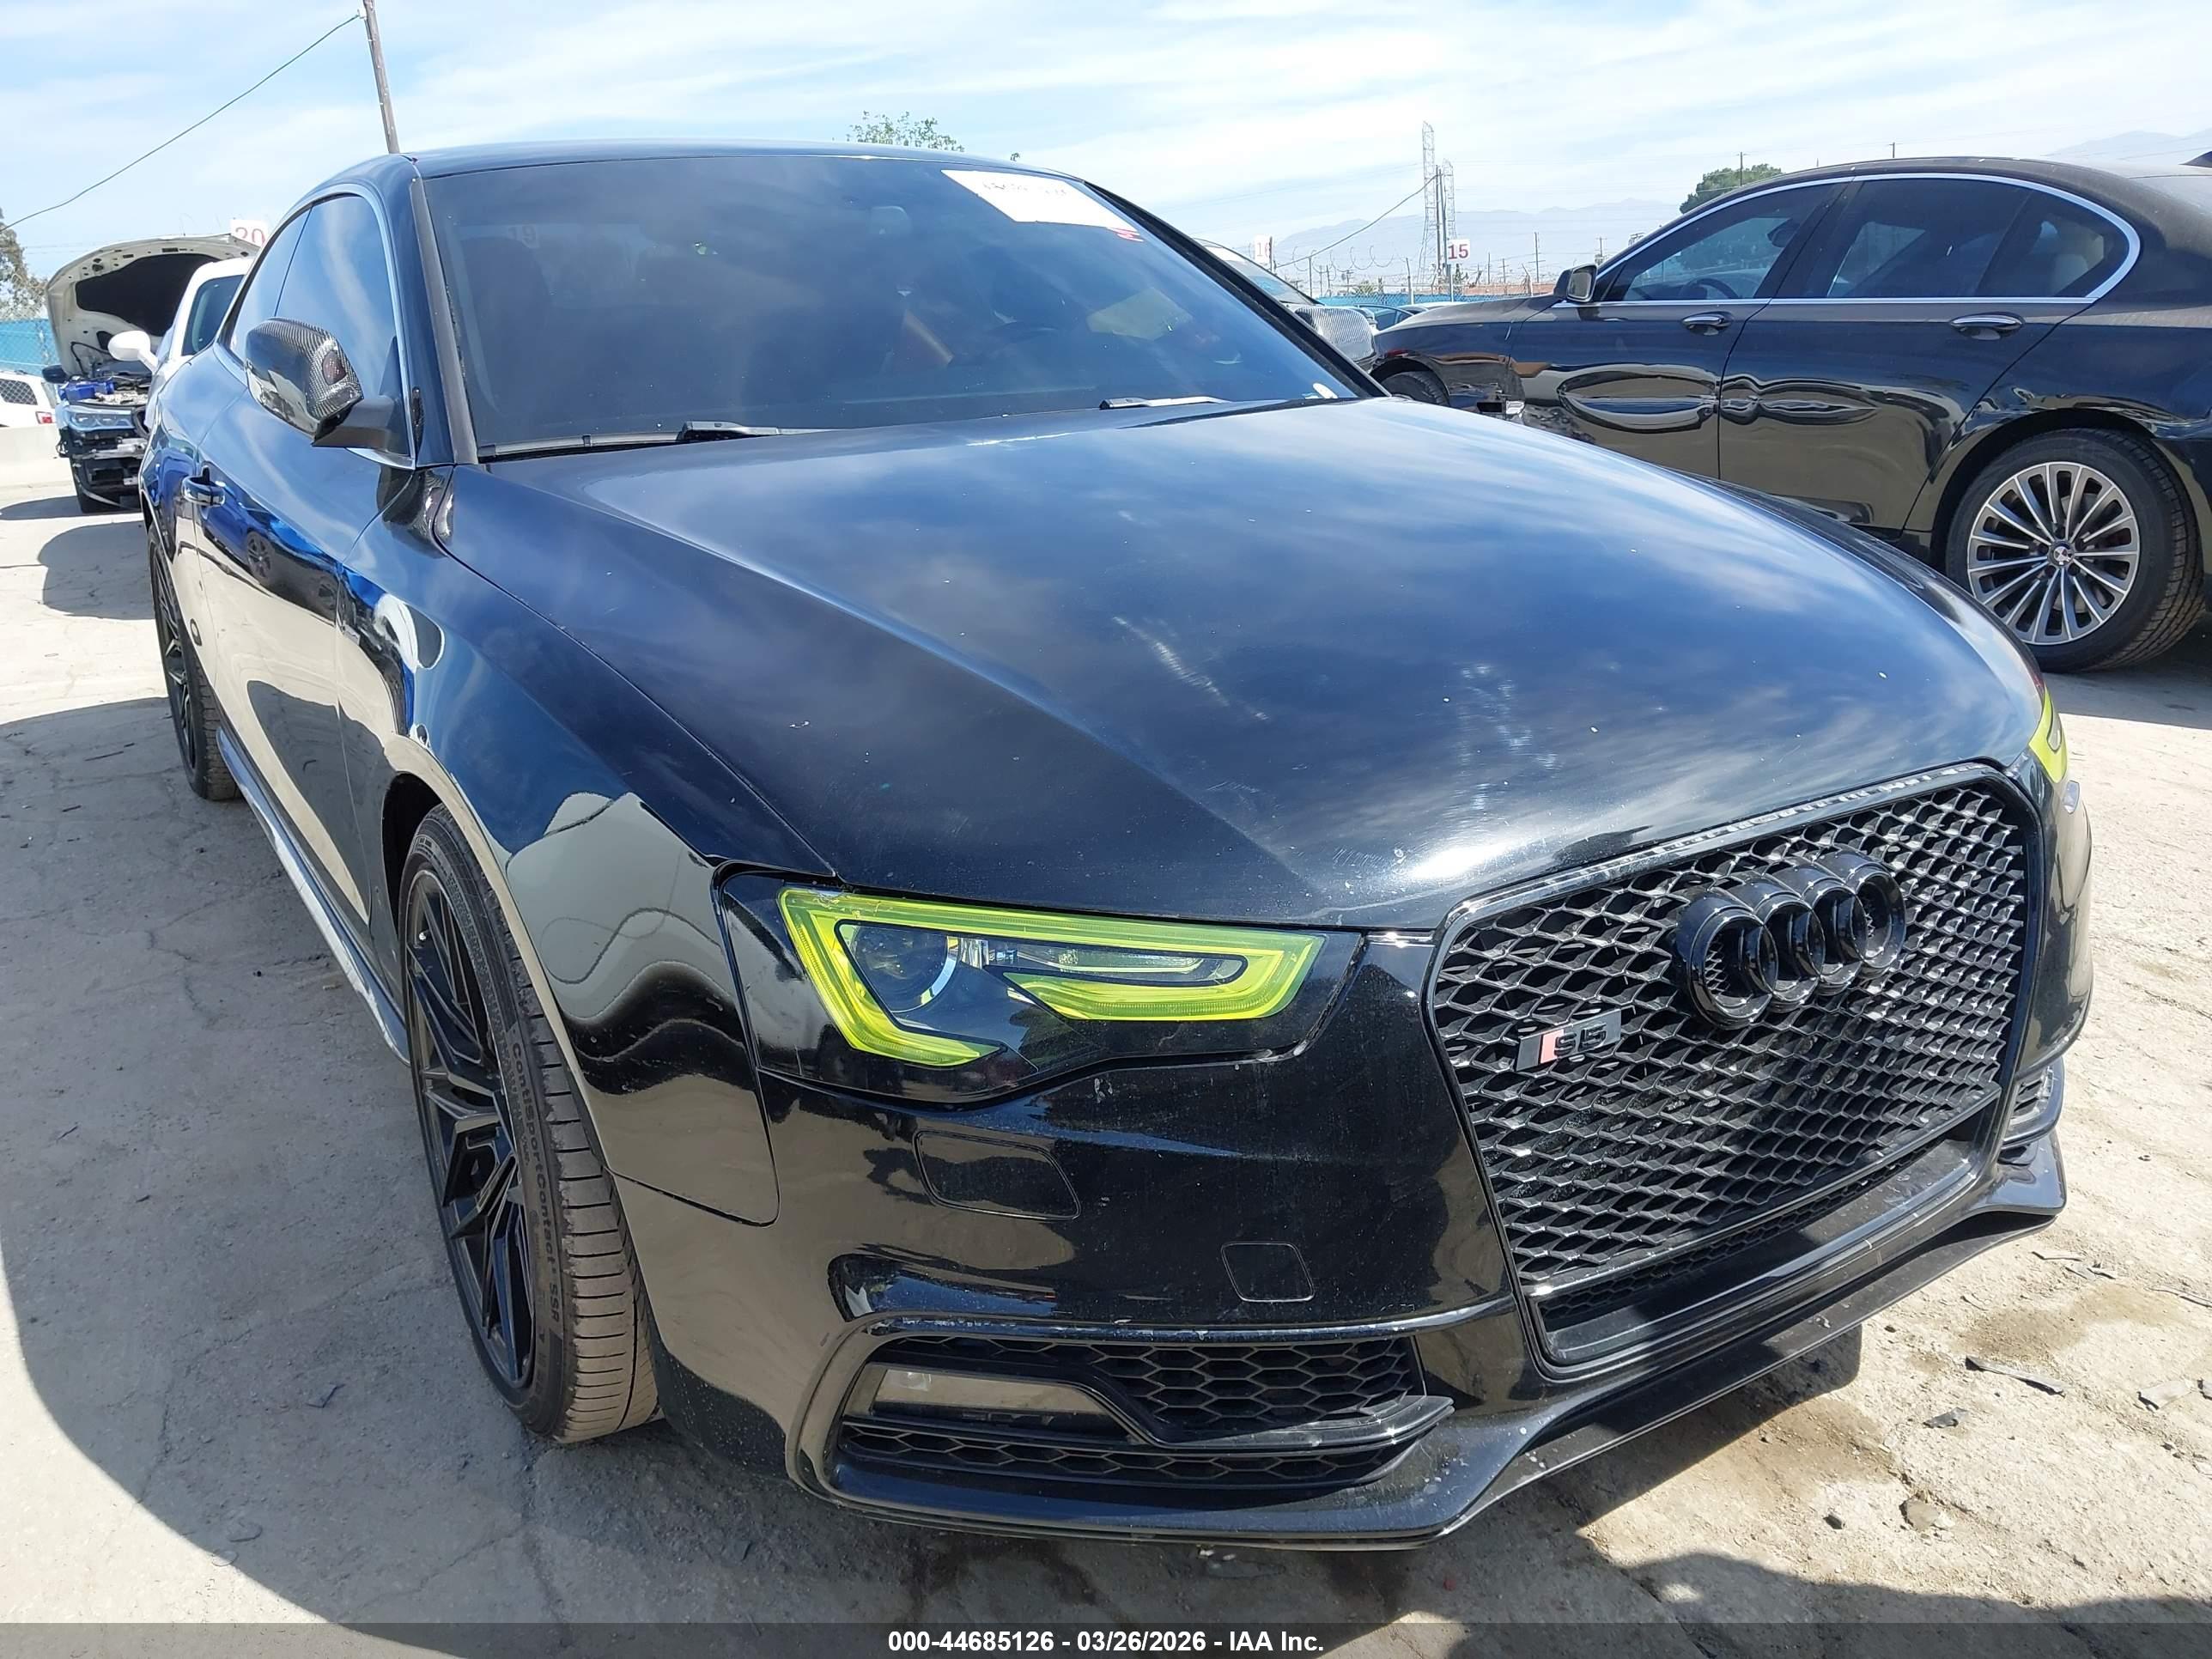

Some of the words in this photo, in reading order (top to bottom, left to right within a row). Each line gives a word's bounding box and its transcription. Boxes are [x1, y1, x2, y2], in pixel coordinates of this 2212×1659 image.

[1448, 244, 1468, 259] 15
[1553, 1023, 1607, 1057] S5
[549, 1282, 559, 1322] SSR
